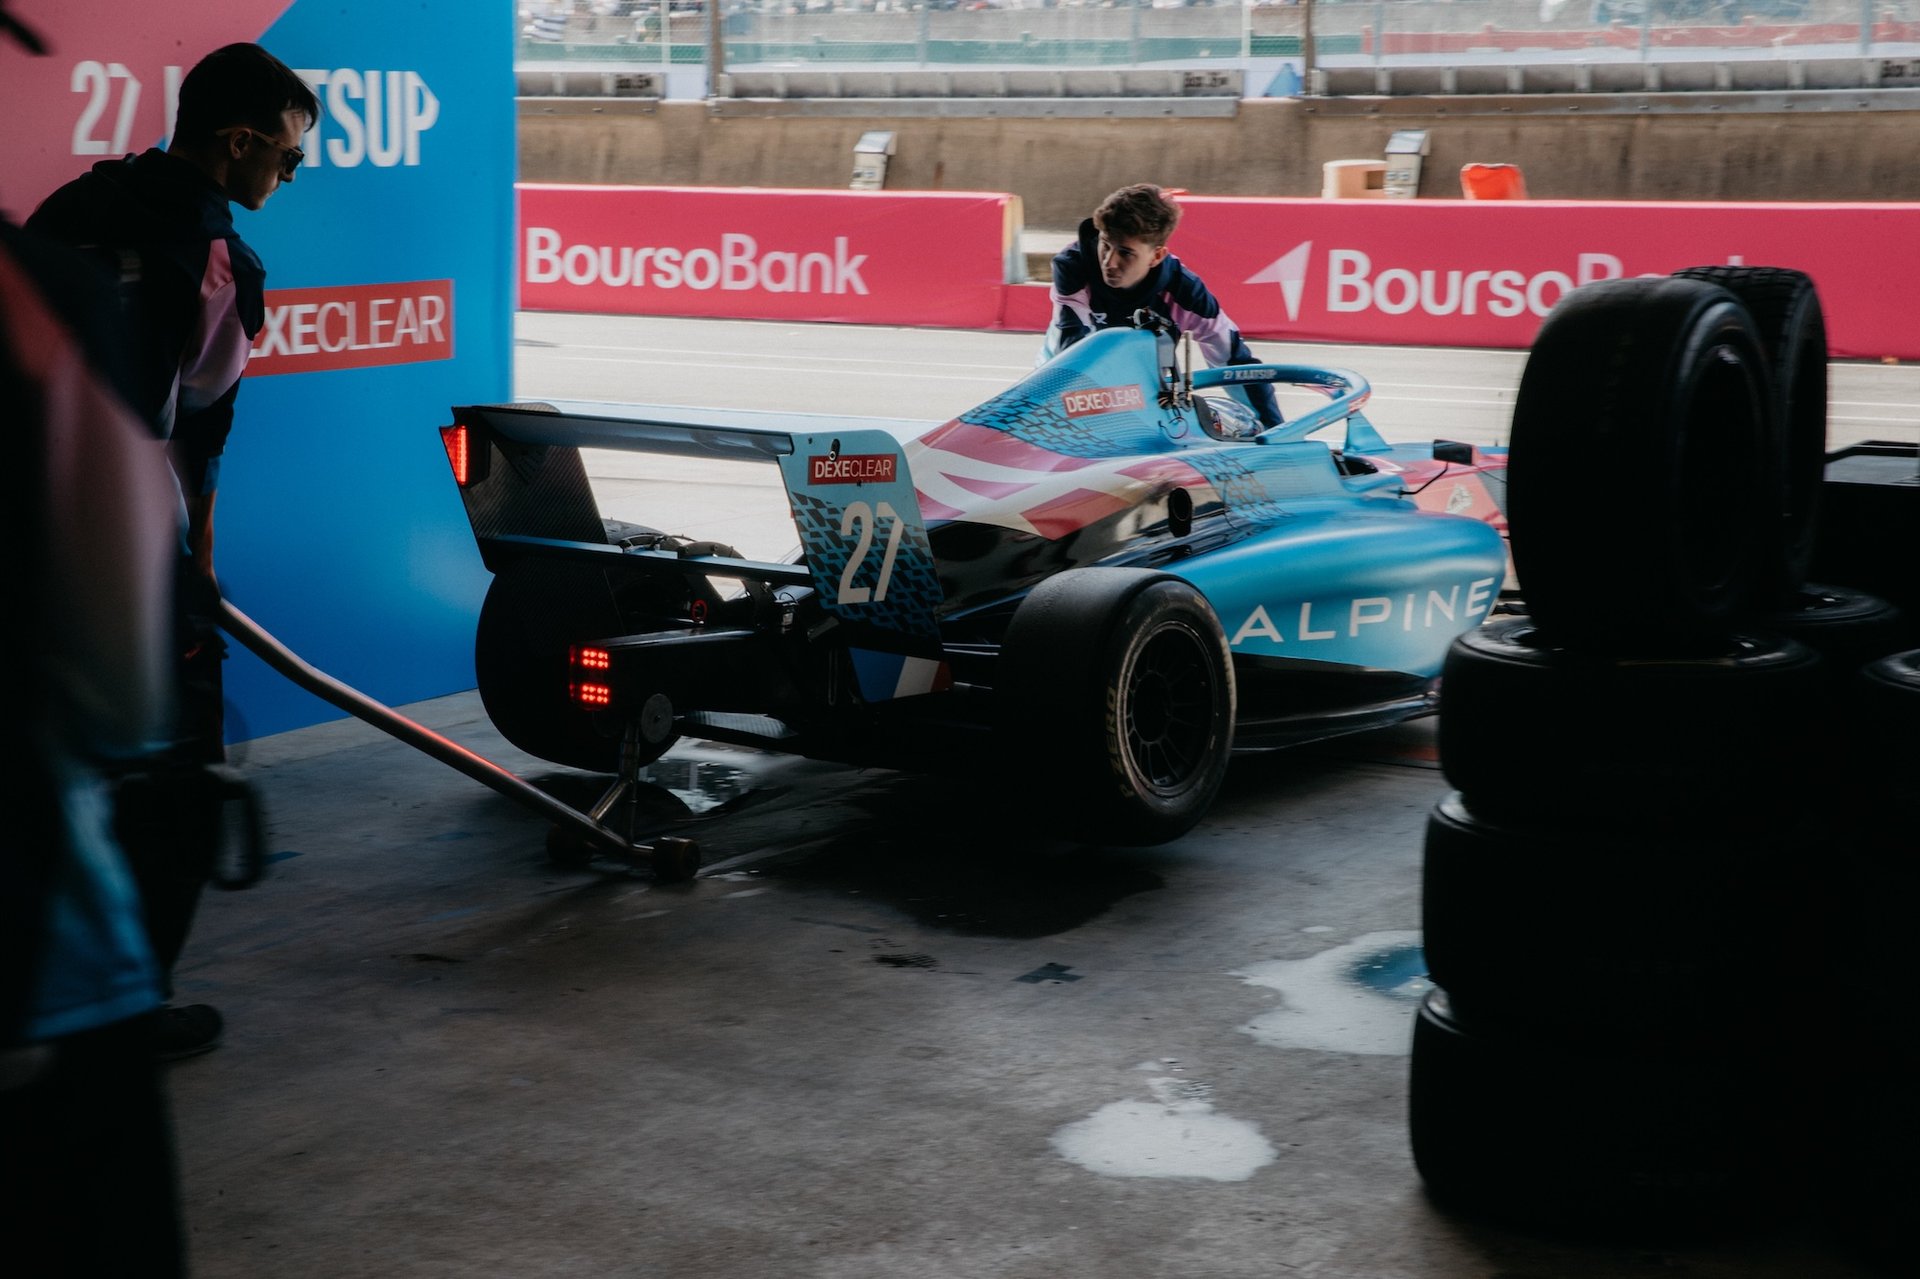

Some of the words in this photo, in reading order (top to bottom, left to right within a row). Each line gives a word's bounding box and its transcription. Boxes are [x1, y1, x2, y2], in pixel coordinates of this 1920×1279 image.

[71, 60, 141, 155] 27
[526, 227, 870, 295] BoursoBank
[1065, 389, 1141, 413] DEXECLEAR
[815, 459, 892, 478] DEXECLEAR
[838, 501, 904, 604] 27
[1230, 577, 1495, 645] ALPINE
